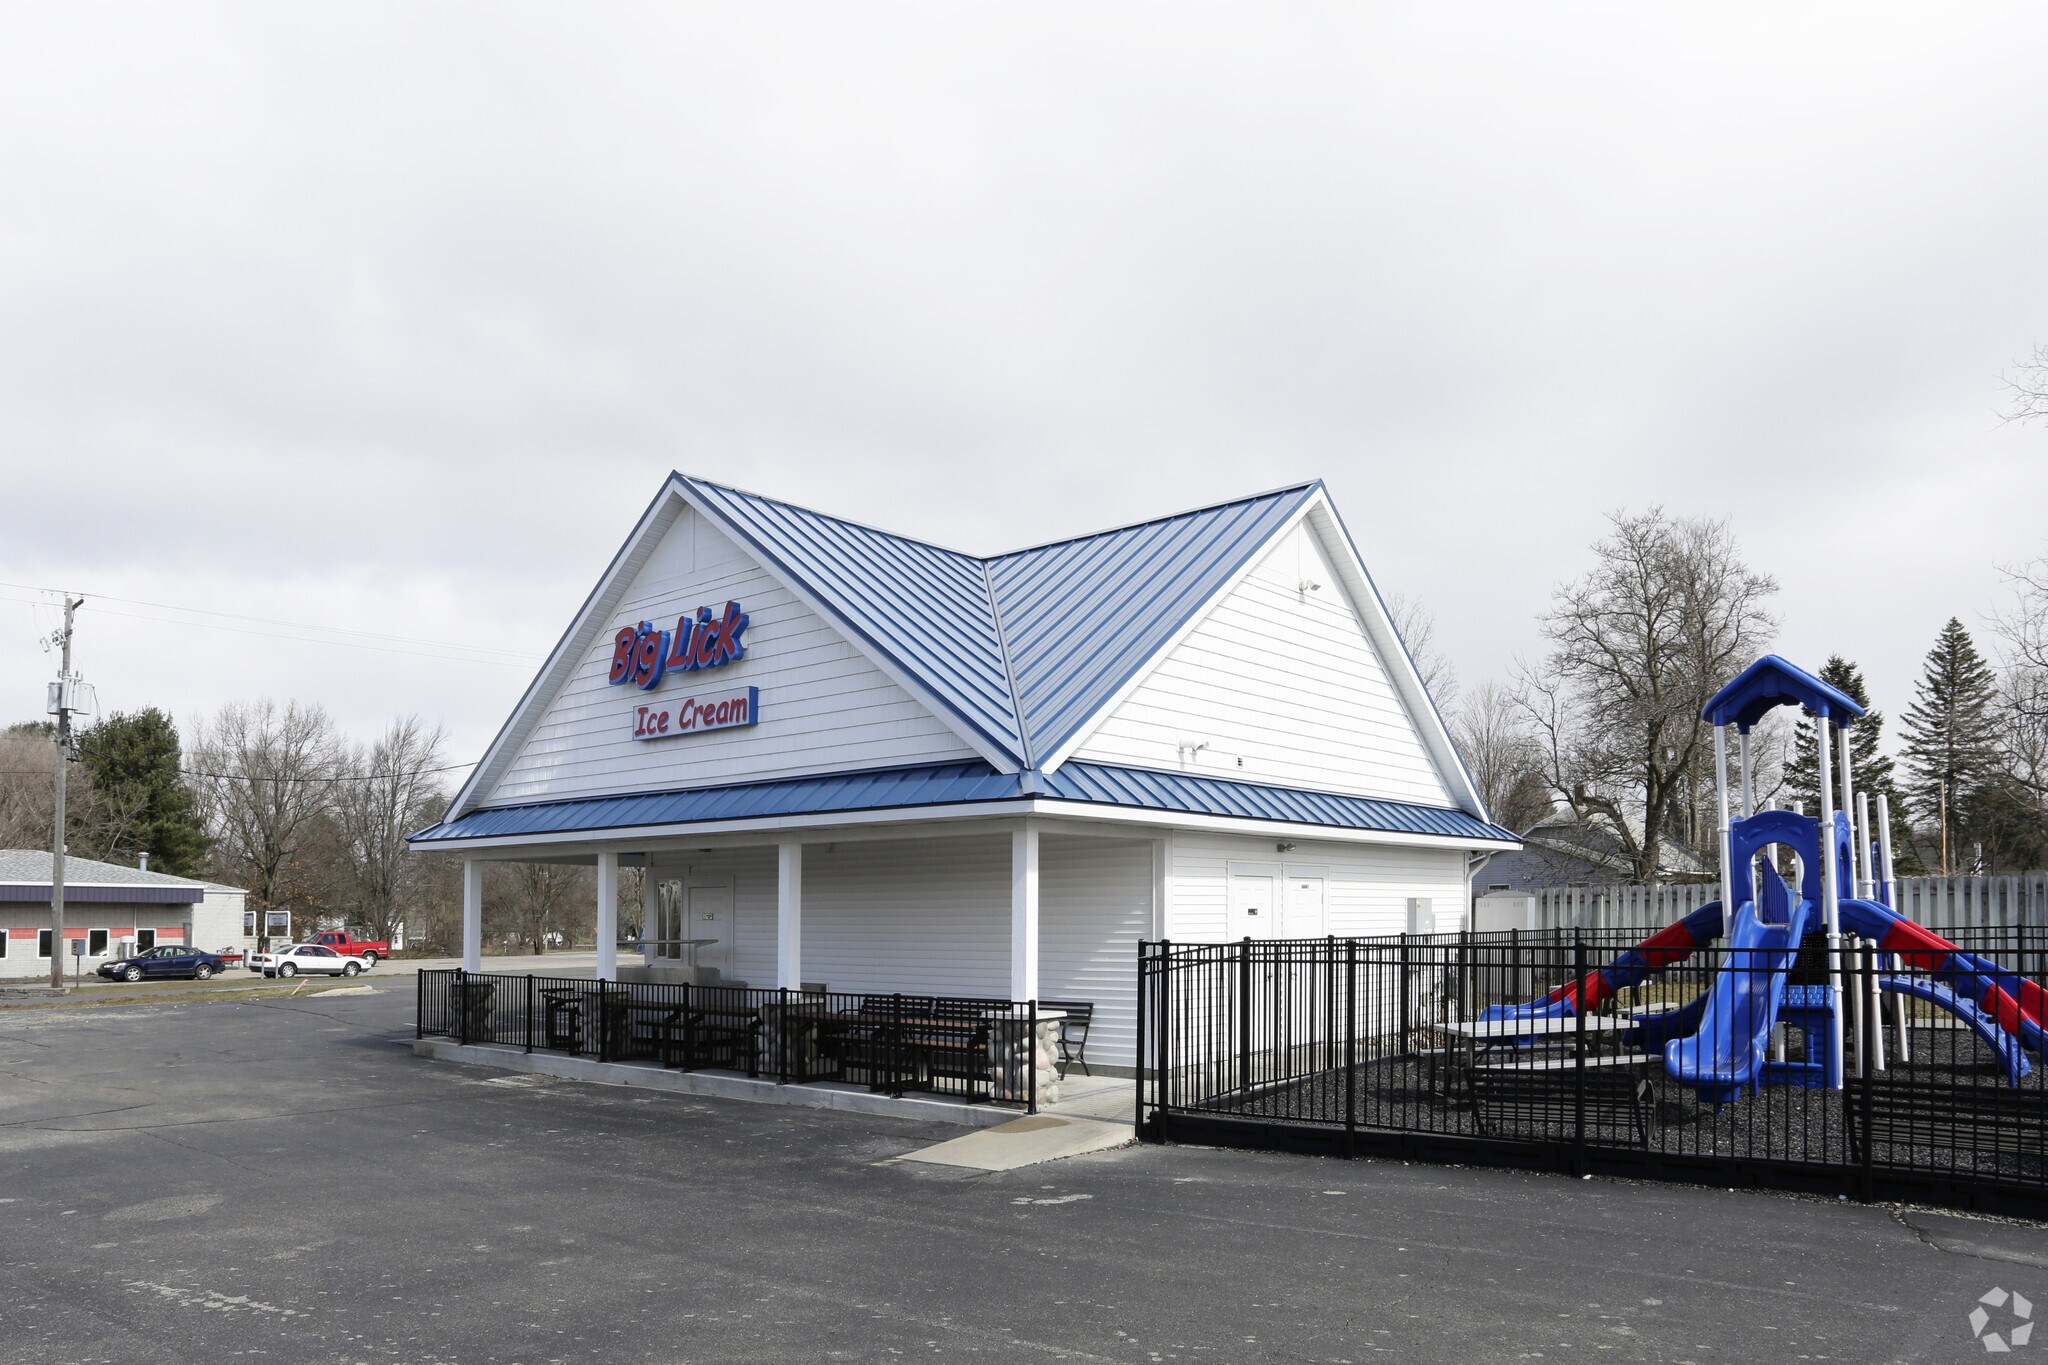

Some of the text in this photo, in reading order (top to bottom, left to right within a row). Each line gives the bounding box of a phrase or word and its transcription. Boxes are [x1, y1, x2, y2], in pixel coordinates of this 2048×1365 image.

[609, 601, 749, 690] Big Lick
[634, 698, 747, 737] Ice Cream
